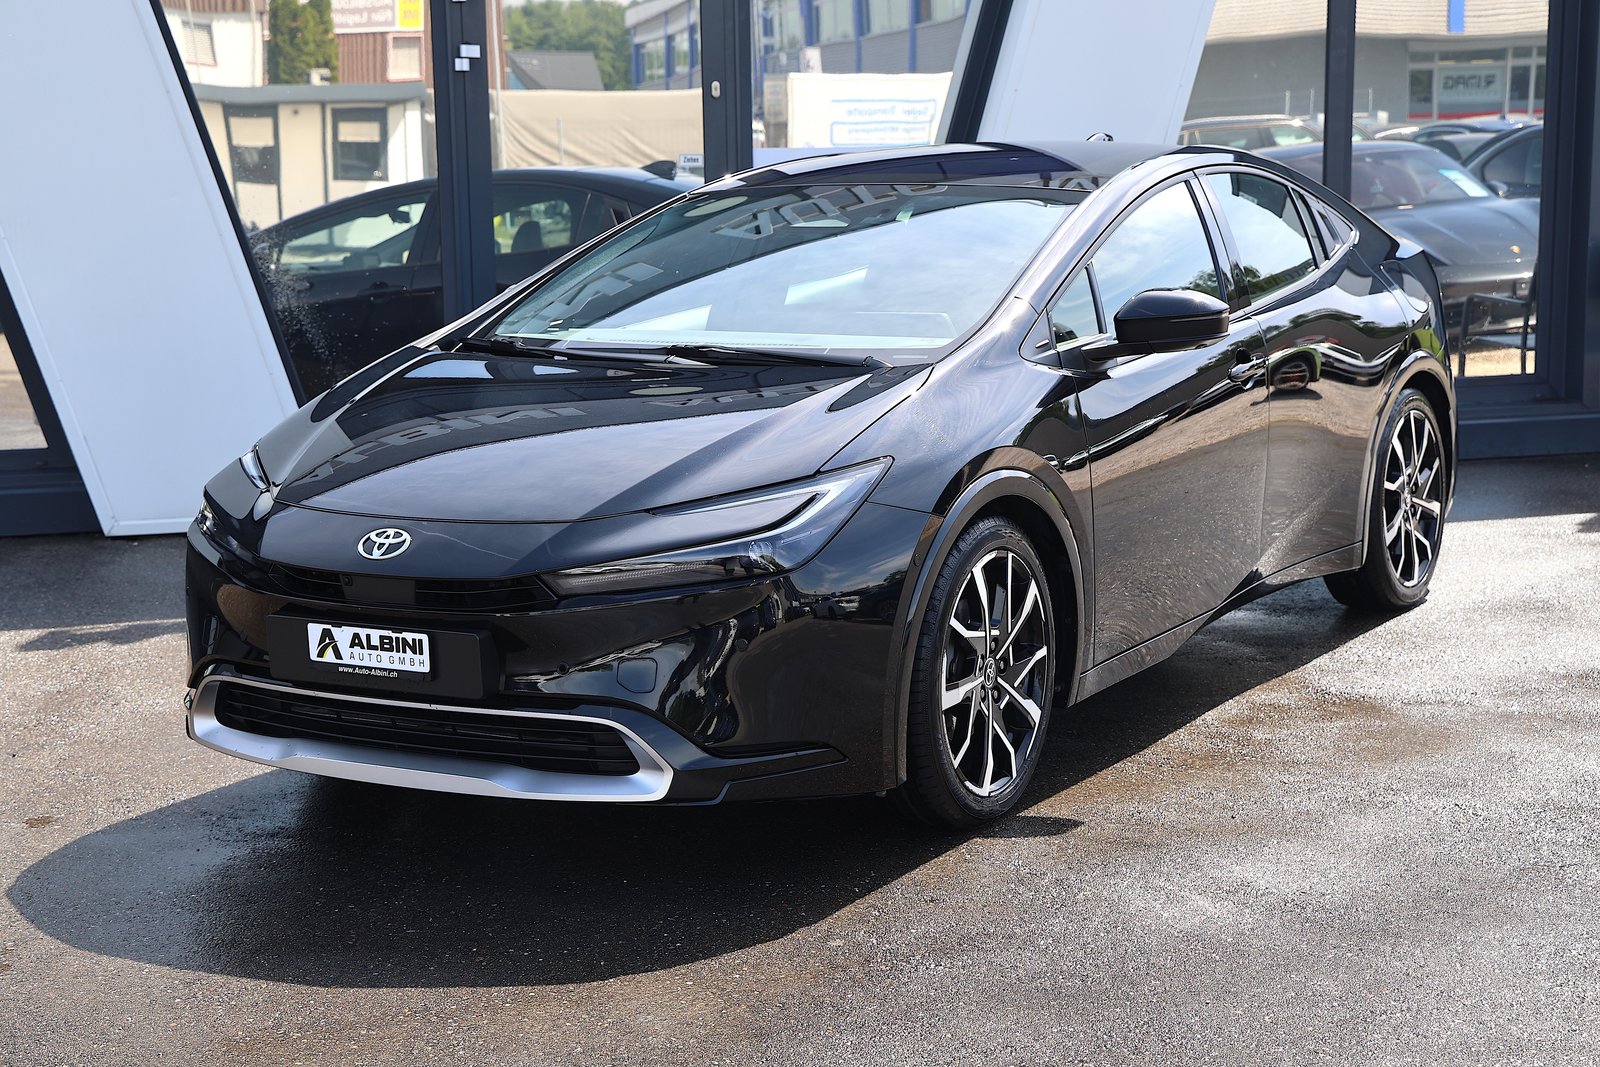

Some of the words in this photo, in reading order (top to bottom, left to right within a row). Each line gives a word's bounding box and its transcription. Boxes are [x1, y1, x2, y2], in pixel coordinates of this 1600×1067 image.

[349, 632, 424, 655] ALBINI
[349, 652, 382, 663] AUTO
[389, 656, 425, 667] GMBH
[338, 666, 398, 677] www.Auto-Albini.ch
